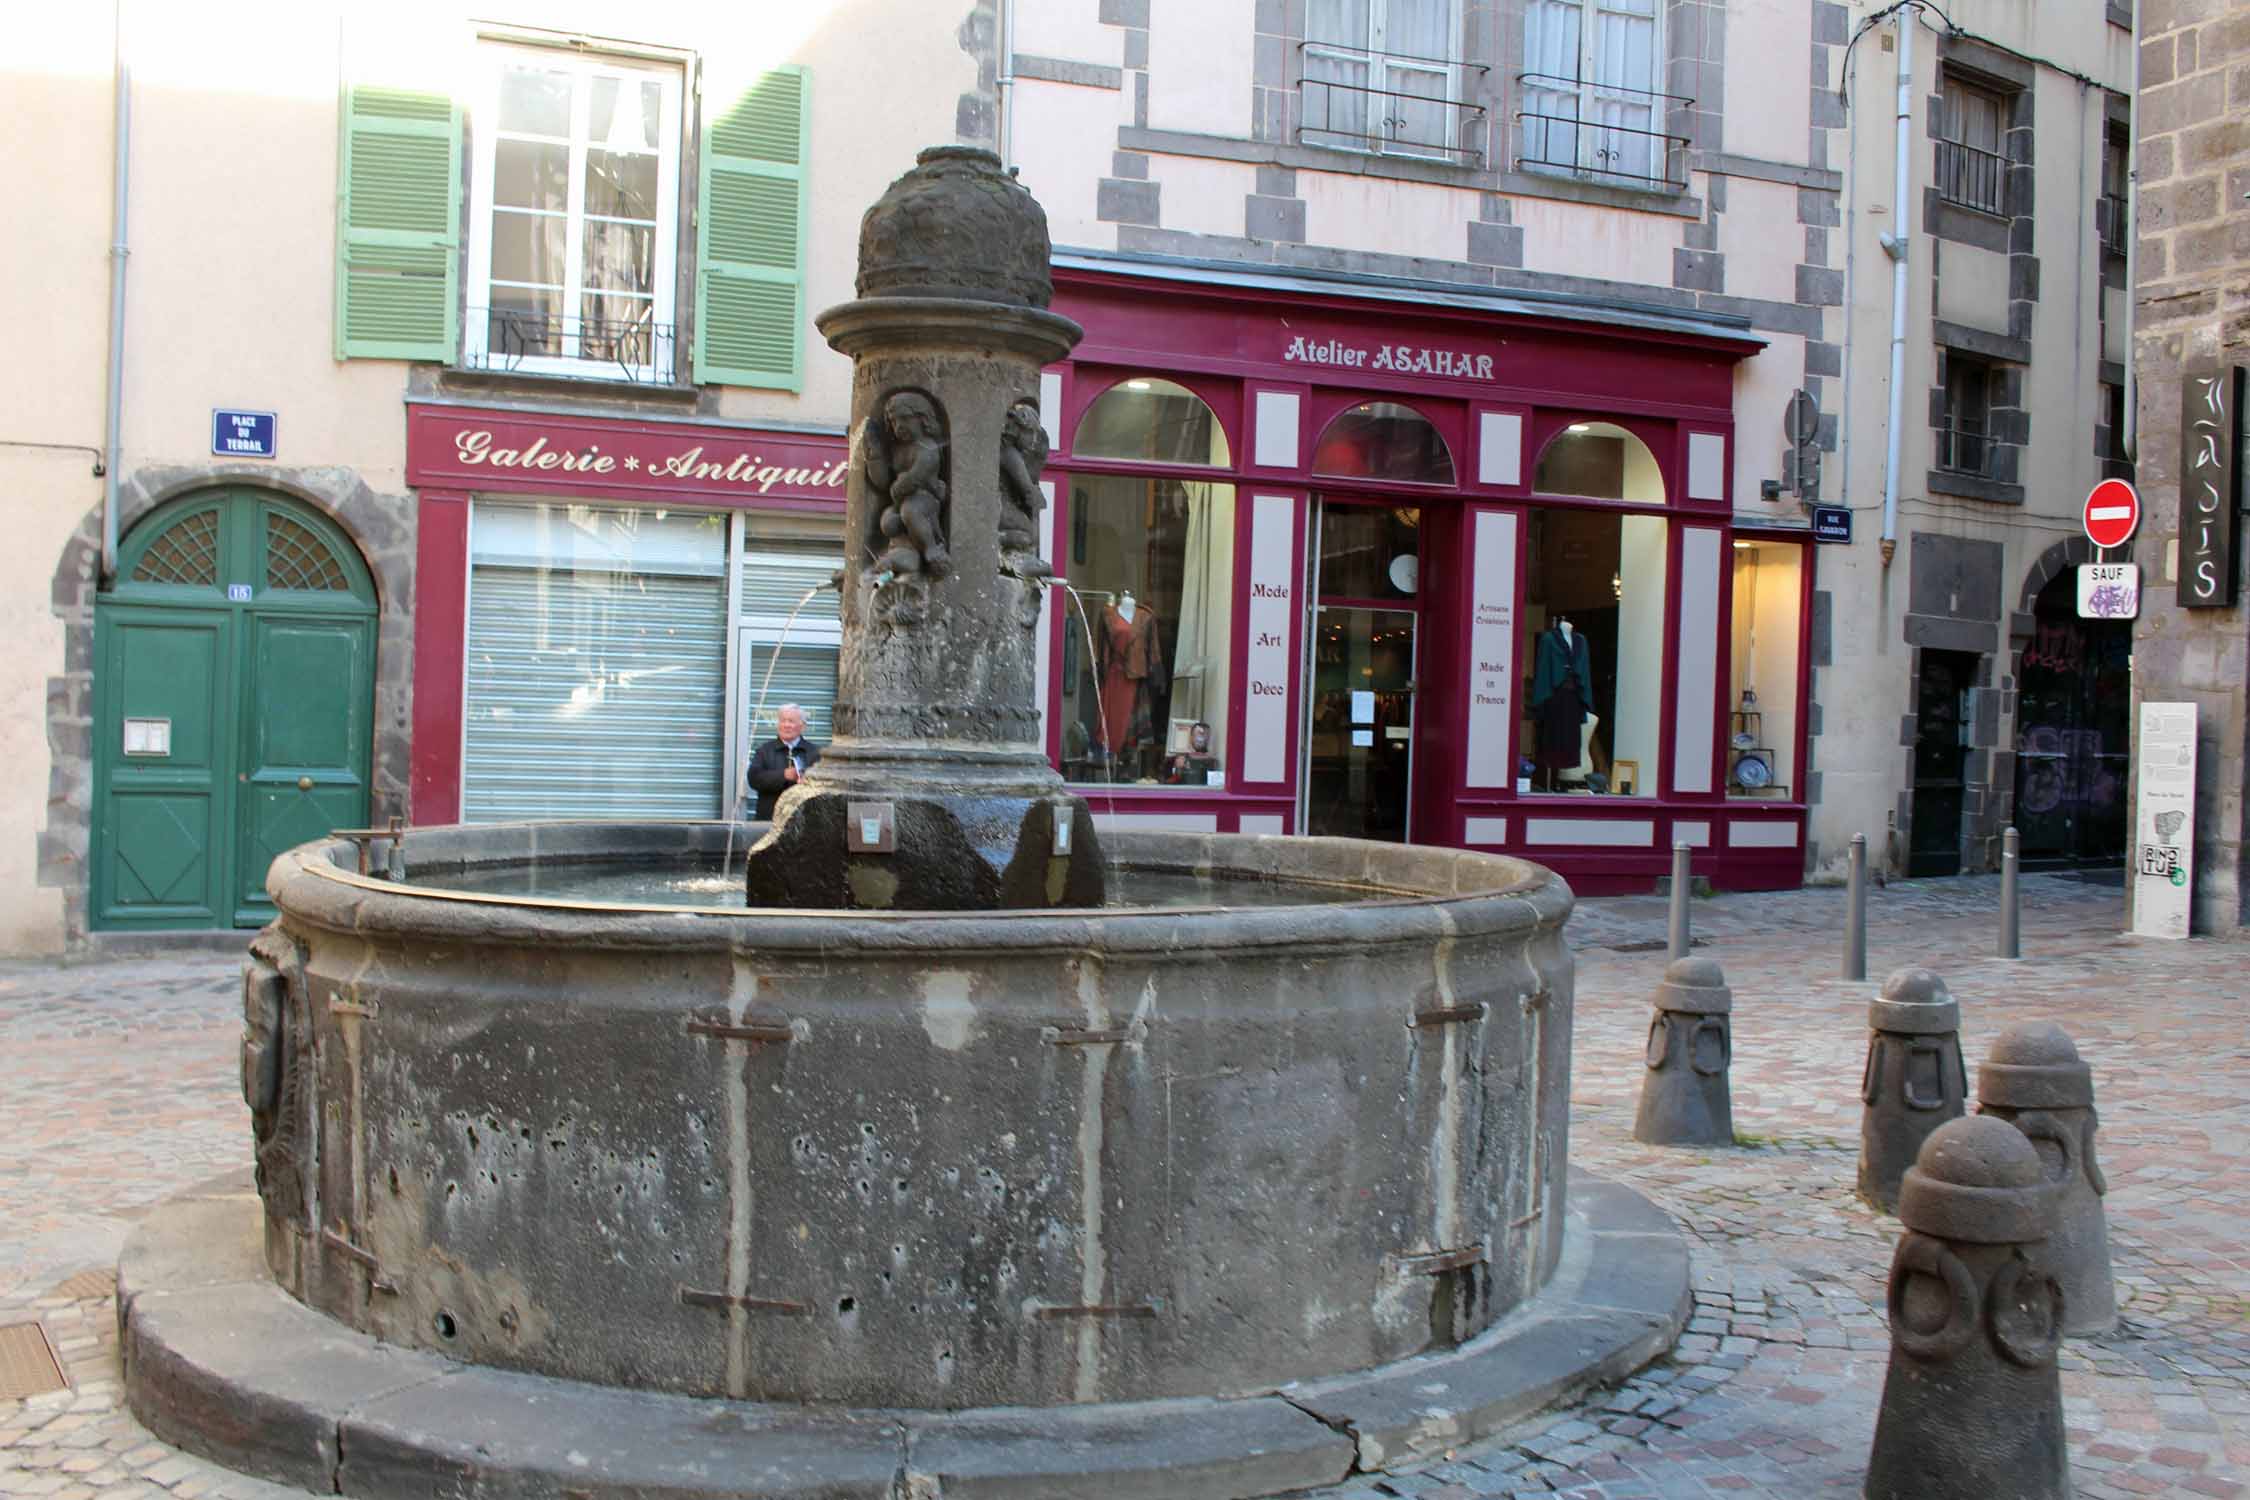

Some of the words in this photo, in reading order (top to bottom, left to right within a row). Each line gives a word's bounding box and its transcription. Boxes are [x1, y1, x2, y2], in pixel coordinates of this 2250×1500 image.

[1284, 335, 1367, 367] Atelier
[1372, 345, 1495, 379] ASAHAR
[232, 415, 256, 428] PLACE
[238, 427, 250, 439] DU
[226, 438, 264, 452] TERRAIL
[455, 430, 617, 474] Galerie
[648, 446, 848, 493] Antiquit
[2091, 567, 2124, 581] SAUF
[1252, 583, 1288, 598] Mode
[1256, 632, 1281, 647] Art
[1479, 661, 1505, 672] Made
[1475, 693, 1506, 704] France
